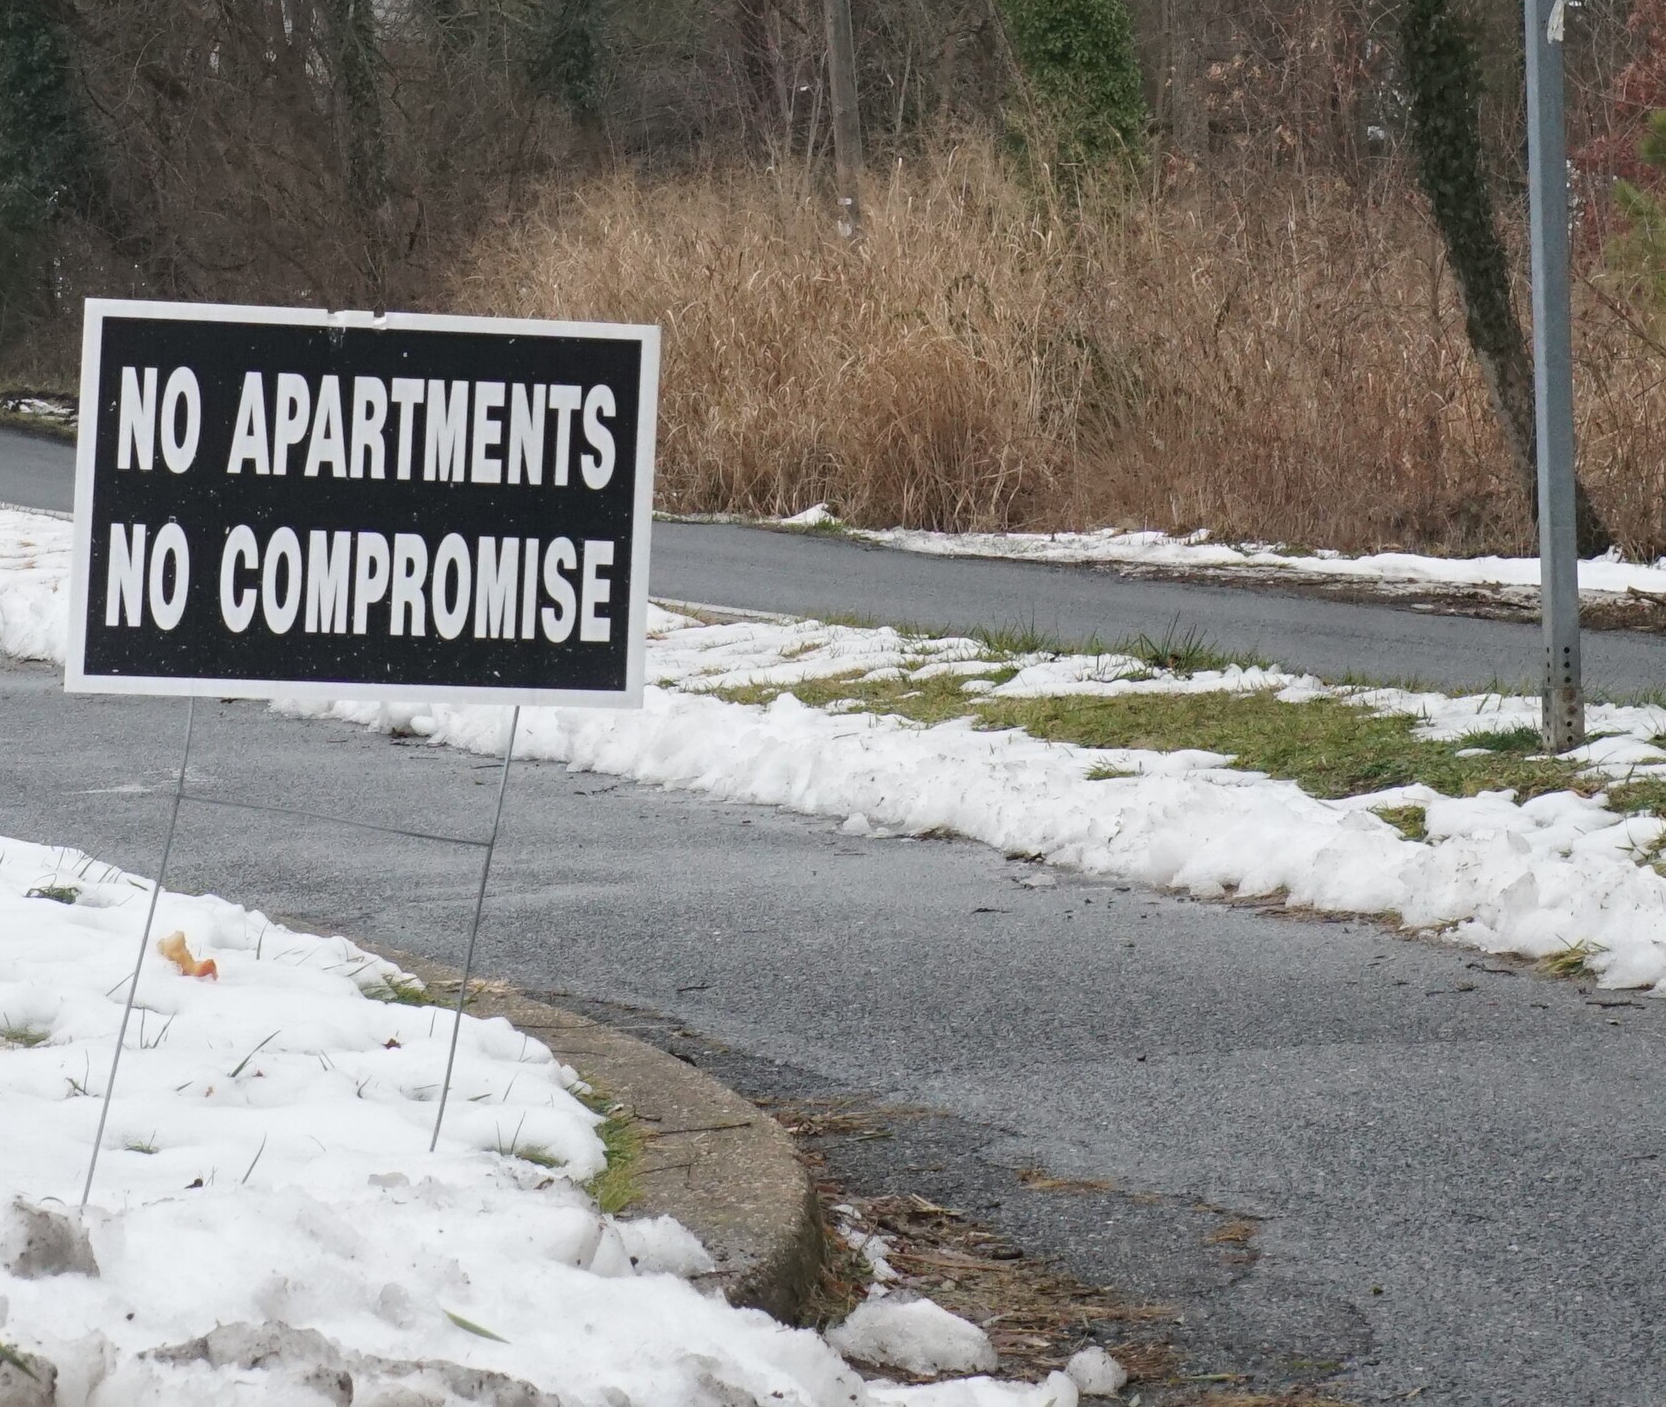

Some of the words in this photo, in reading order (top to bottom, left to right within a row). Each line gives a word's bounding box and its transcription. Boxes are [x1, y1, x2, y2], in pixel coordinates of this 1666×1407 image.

[117, 366, 201, 474] NO
[226, 371, 617, 490] APARTMENTS
[105, 522, 190, 631] NO
[219, 524, 615, 644] COMPROMISE
